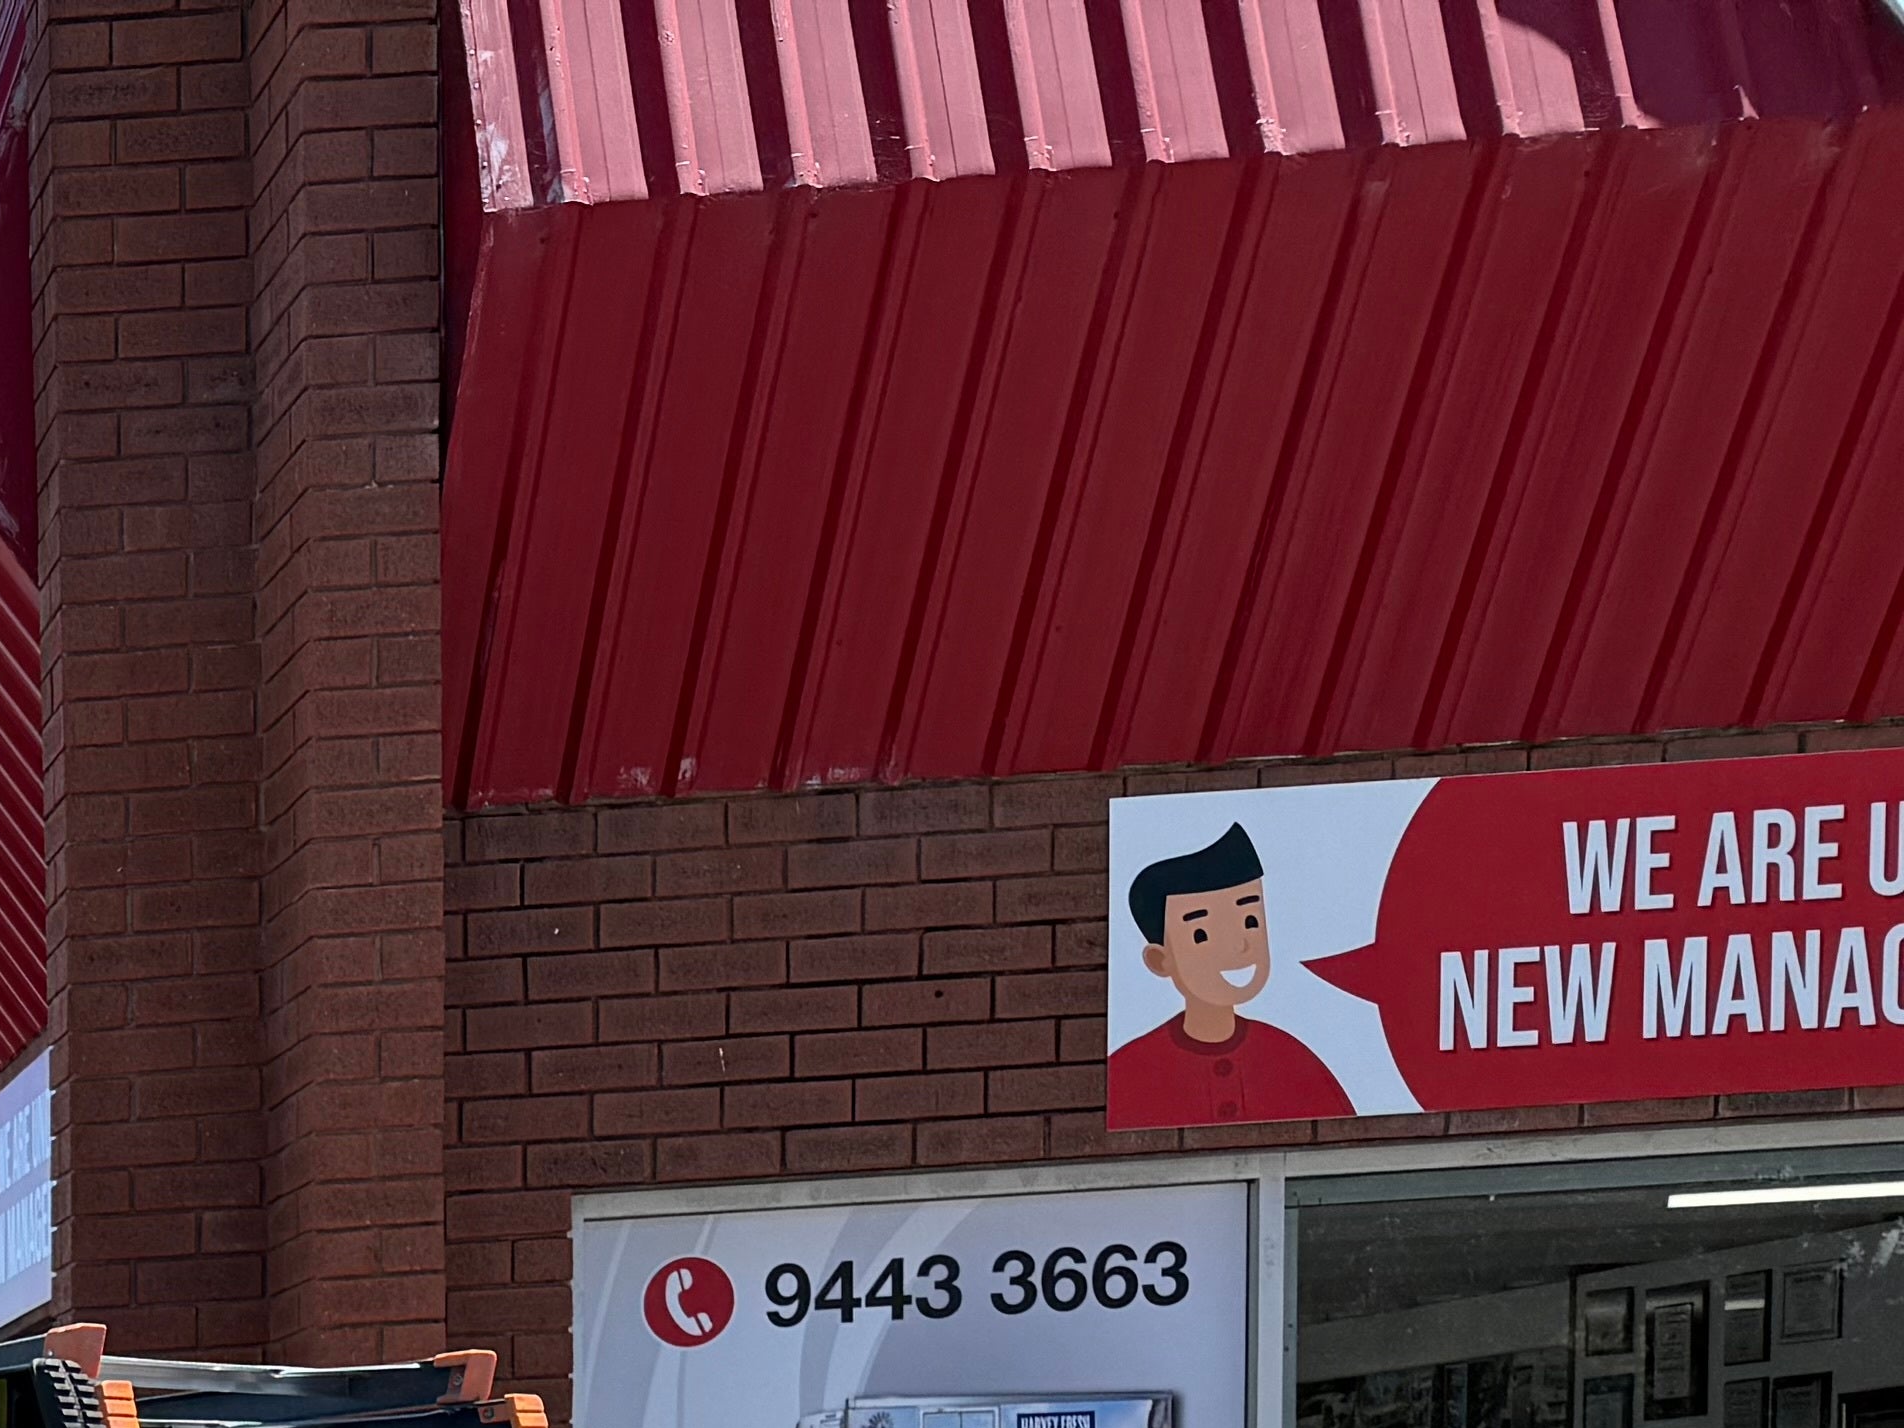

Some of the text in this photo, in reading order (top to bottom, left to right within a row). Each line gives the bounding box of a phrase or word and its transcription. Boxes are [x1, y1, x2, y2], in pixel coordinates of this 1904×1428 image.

[1562, 814, 1677, 914] WE
[1697, 803, 1846, 908] ARE
[1439, 941, 1617, 1052] NEW
[764, 1241, 1190, 1328] 9443 3663
